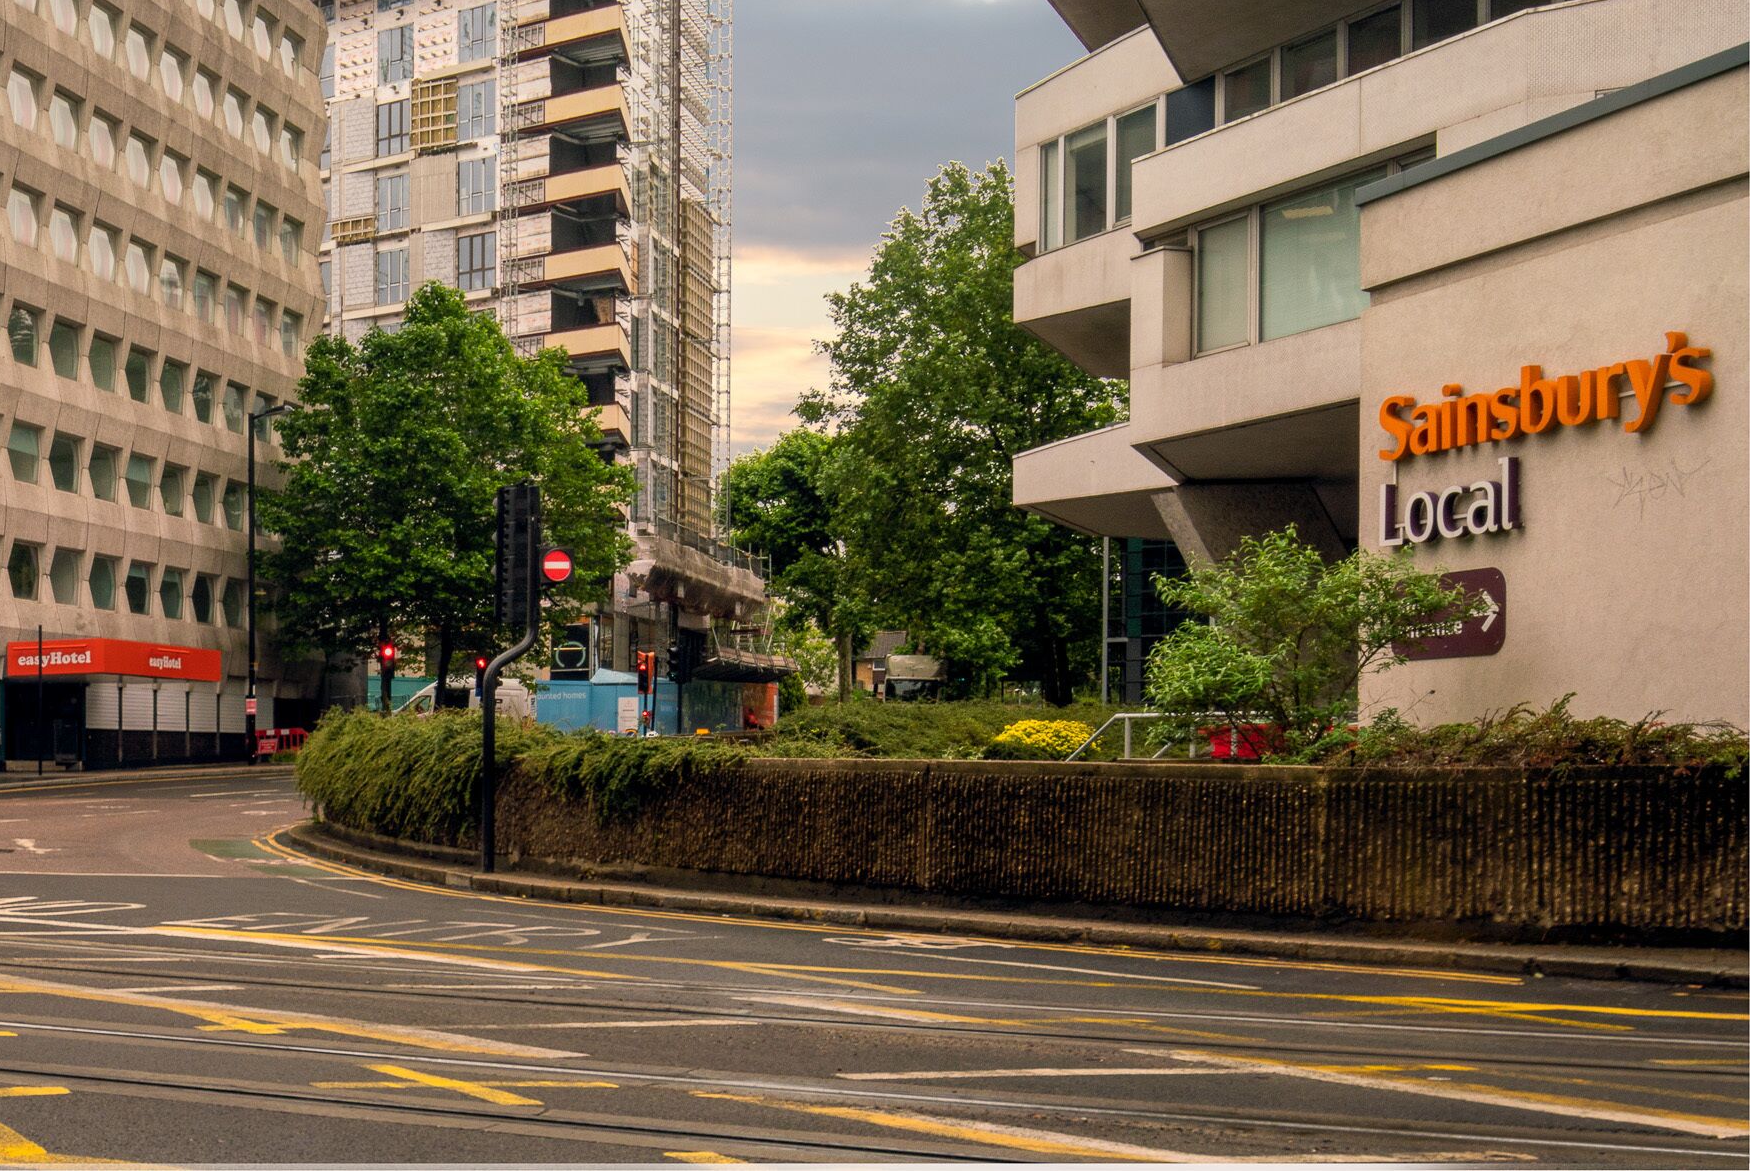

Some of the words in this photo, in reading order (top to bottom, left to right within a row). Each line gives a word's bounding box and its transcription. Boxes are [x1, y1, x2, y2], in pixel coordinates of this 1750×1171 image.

[1378, 331, 1714, 462] Sainsbury's
[1379, 456, 1520, 546] Local
[17, 650, 92, 668] easyHotel
[149, 655, 182, 670] easyHotel
[537, 692, 562, 700] ounted
[563, 691, 586, 699] homes
